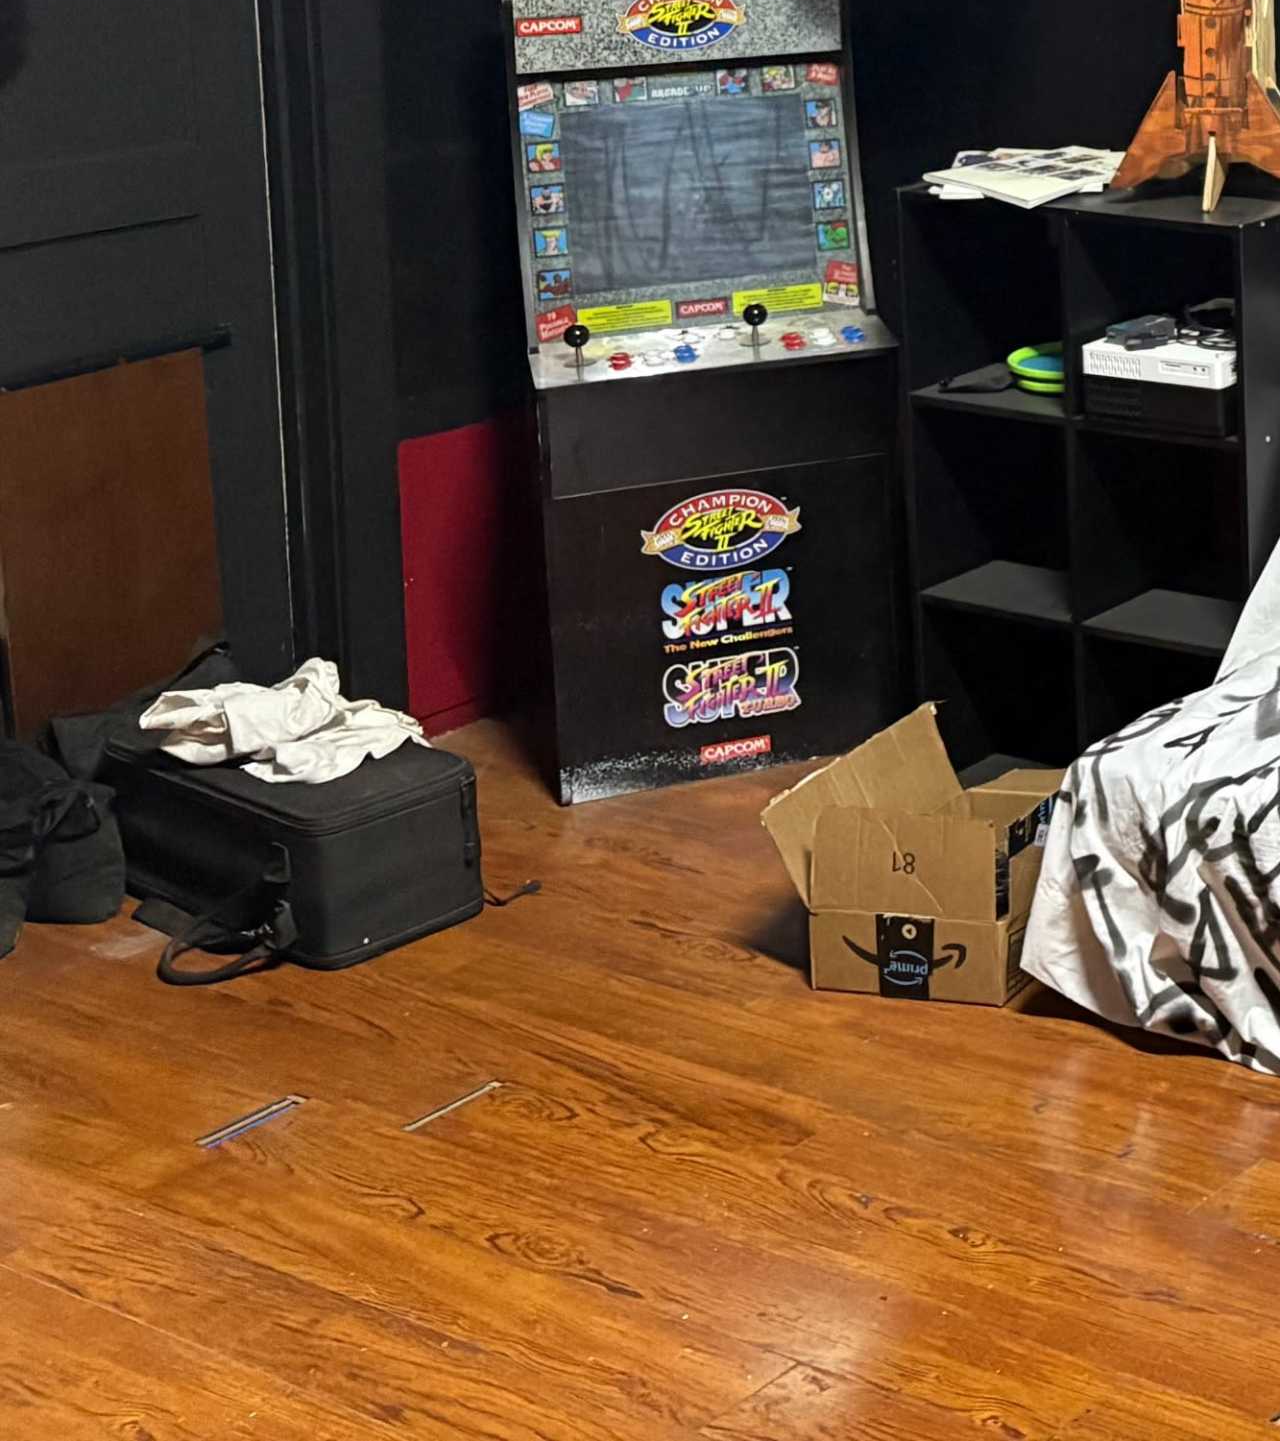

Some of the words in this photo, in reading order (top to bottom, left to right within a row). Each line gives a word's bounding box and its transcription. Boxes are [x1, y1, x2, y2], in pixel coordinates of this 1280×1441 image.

[520, 20, 577, 33] CAPCOM
[647, 28, 719, 47] EDITION
[680, 302, 724, 314] CAPCOM
[669, 494, 772, 526] CHAMPION
[680, 538, 768, 566] EDITION
[661, 568, 792, 639] SER
[664, 643, 687, 654] The
[690, 639, 719, 650] New
[704, 739, 766, 759] CAPCOM
[886, 960, 929, 976] prime
